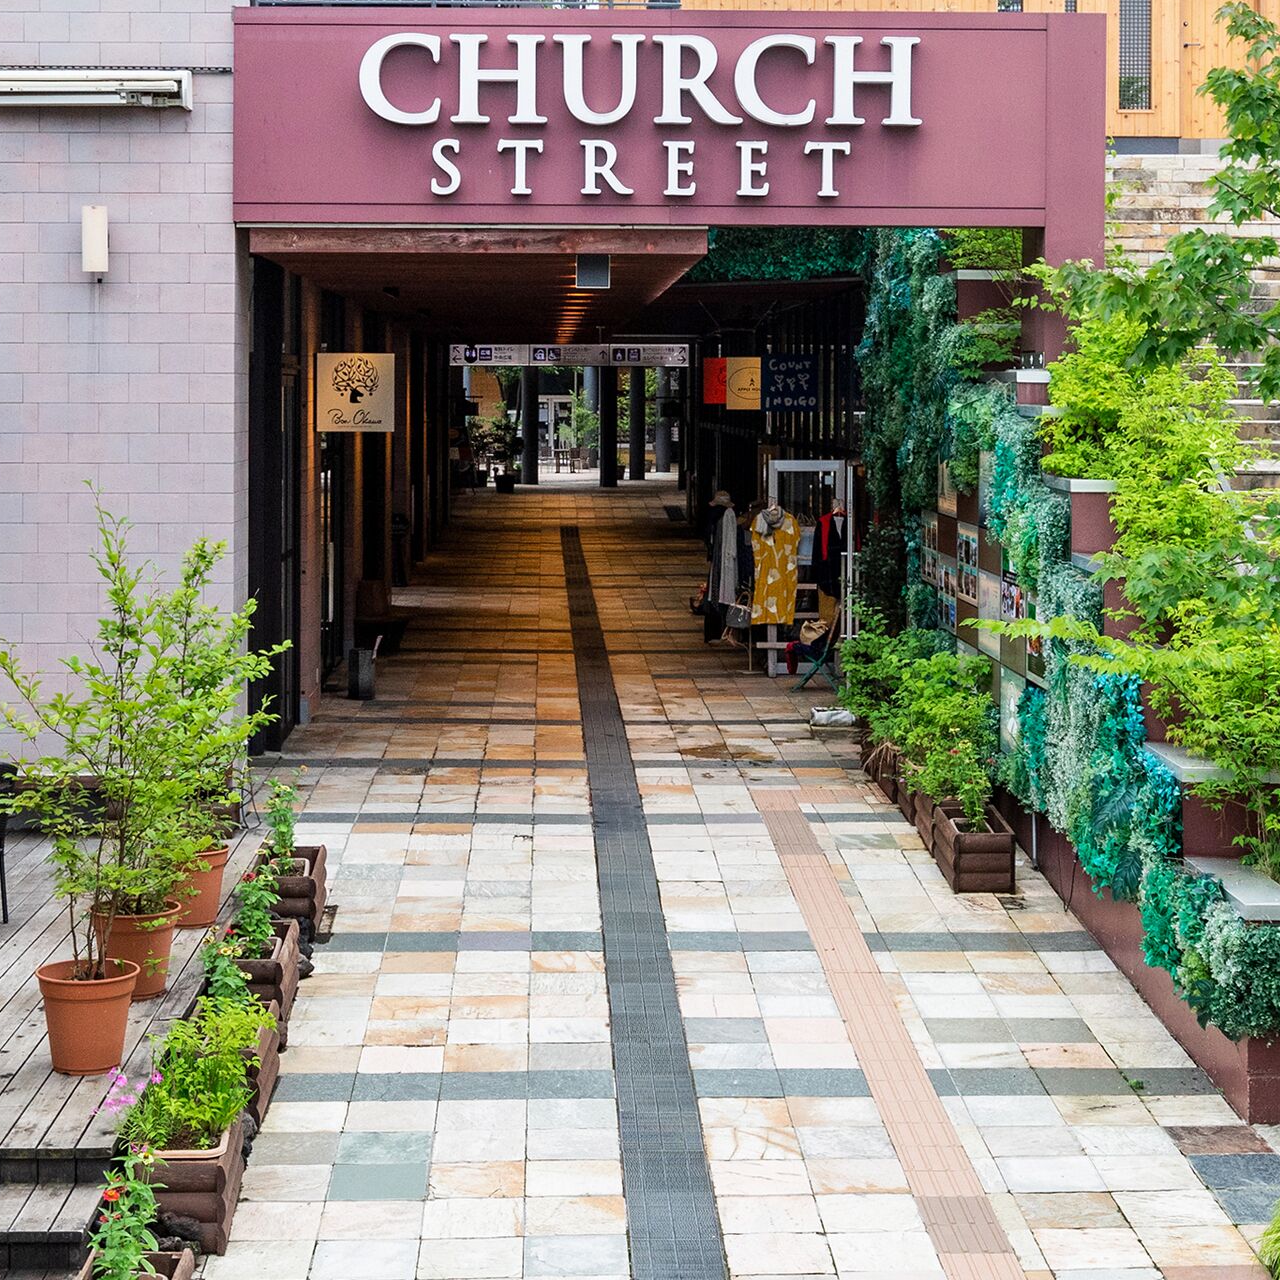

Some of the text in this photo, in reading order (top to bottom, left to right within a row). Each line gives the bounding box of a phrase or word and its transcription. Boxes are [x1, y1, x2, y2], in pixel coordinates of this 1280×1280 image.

[358, 32, 923, 127] CHURCH
[429, 138, 852, 198] STREET
[769, 359, 812, 370] COUNT
[766, 396, 817, 408] INDIGO
